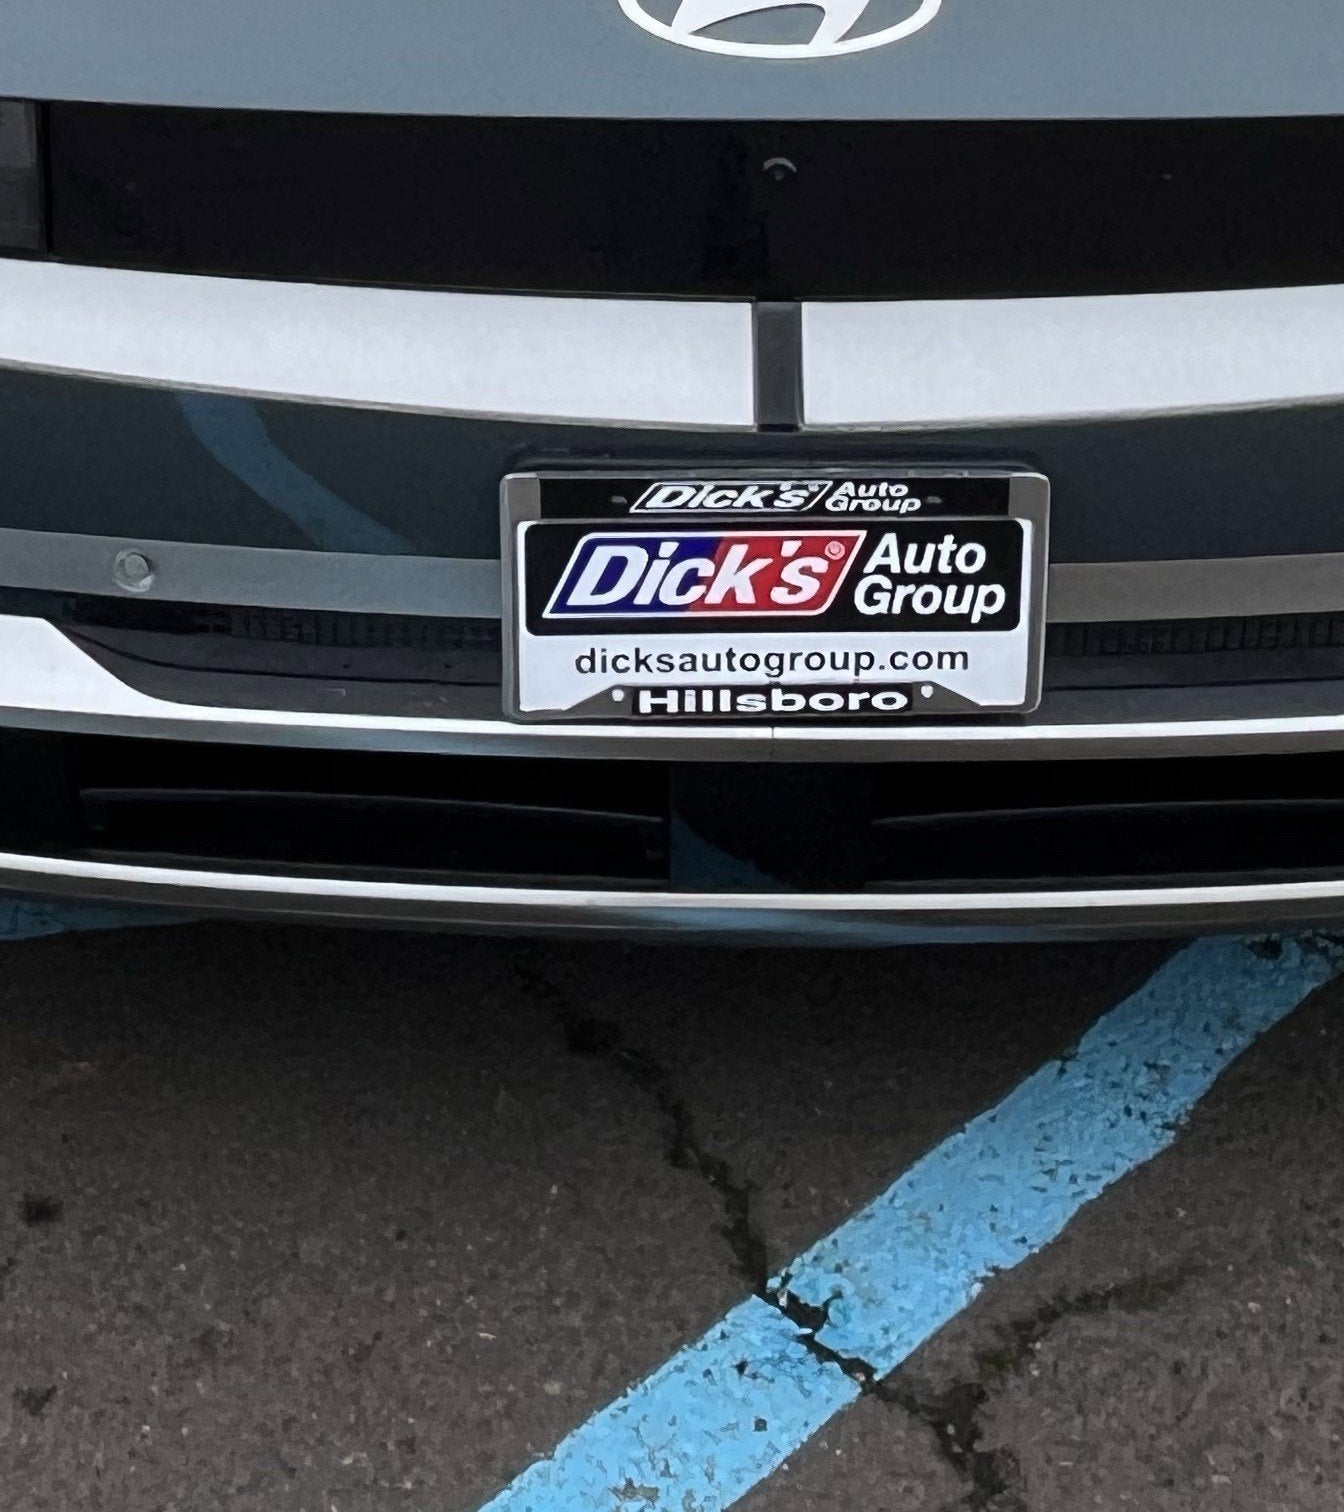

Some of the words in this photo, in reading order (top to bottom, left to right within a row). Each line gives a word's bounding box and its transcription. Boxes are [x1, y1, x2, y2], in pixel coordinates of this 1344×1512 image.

[645, 483, 808, 509] Dick's
[833, 481, 908, 497] Auto
[824, 496, 921, 514] Group
[863, 533, 987, 575] Auto
[566, 541, 830, 606] Dick's
[854, 574, 1006, 624] Group
[575, 646, 970, 678] dicksautogroup.com
[637, 688, 909, 714] Hillsboro
